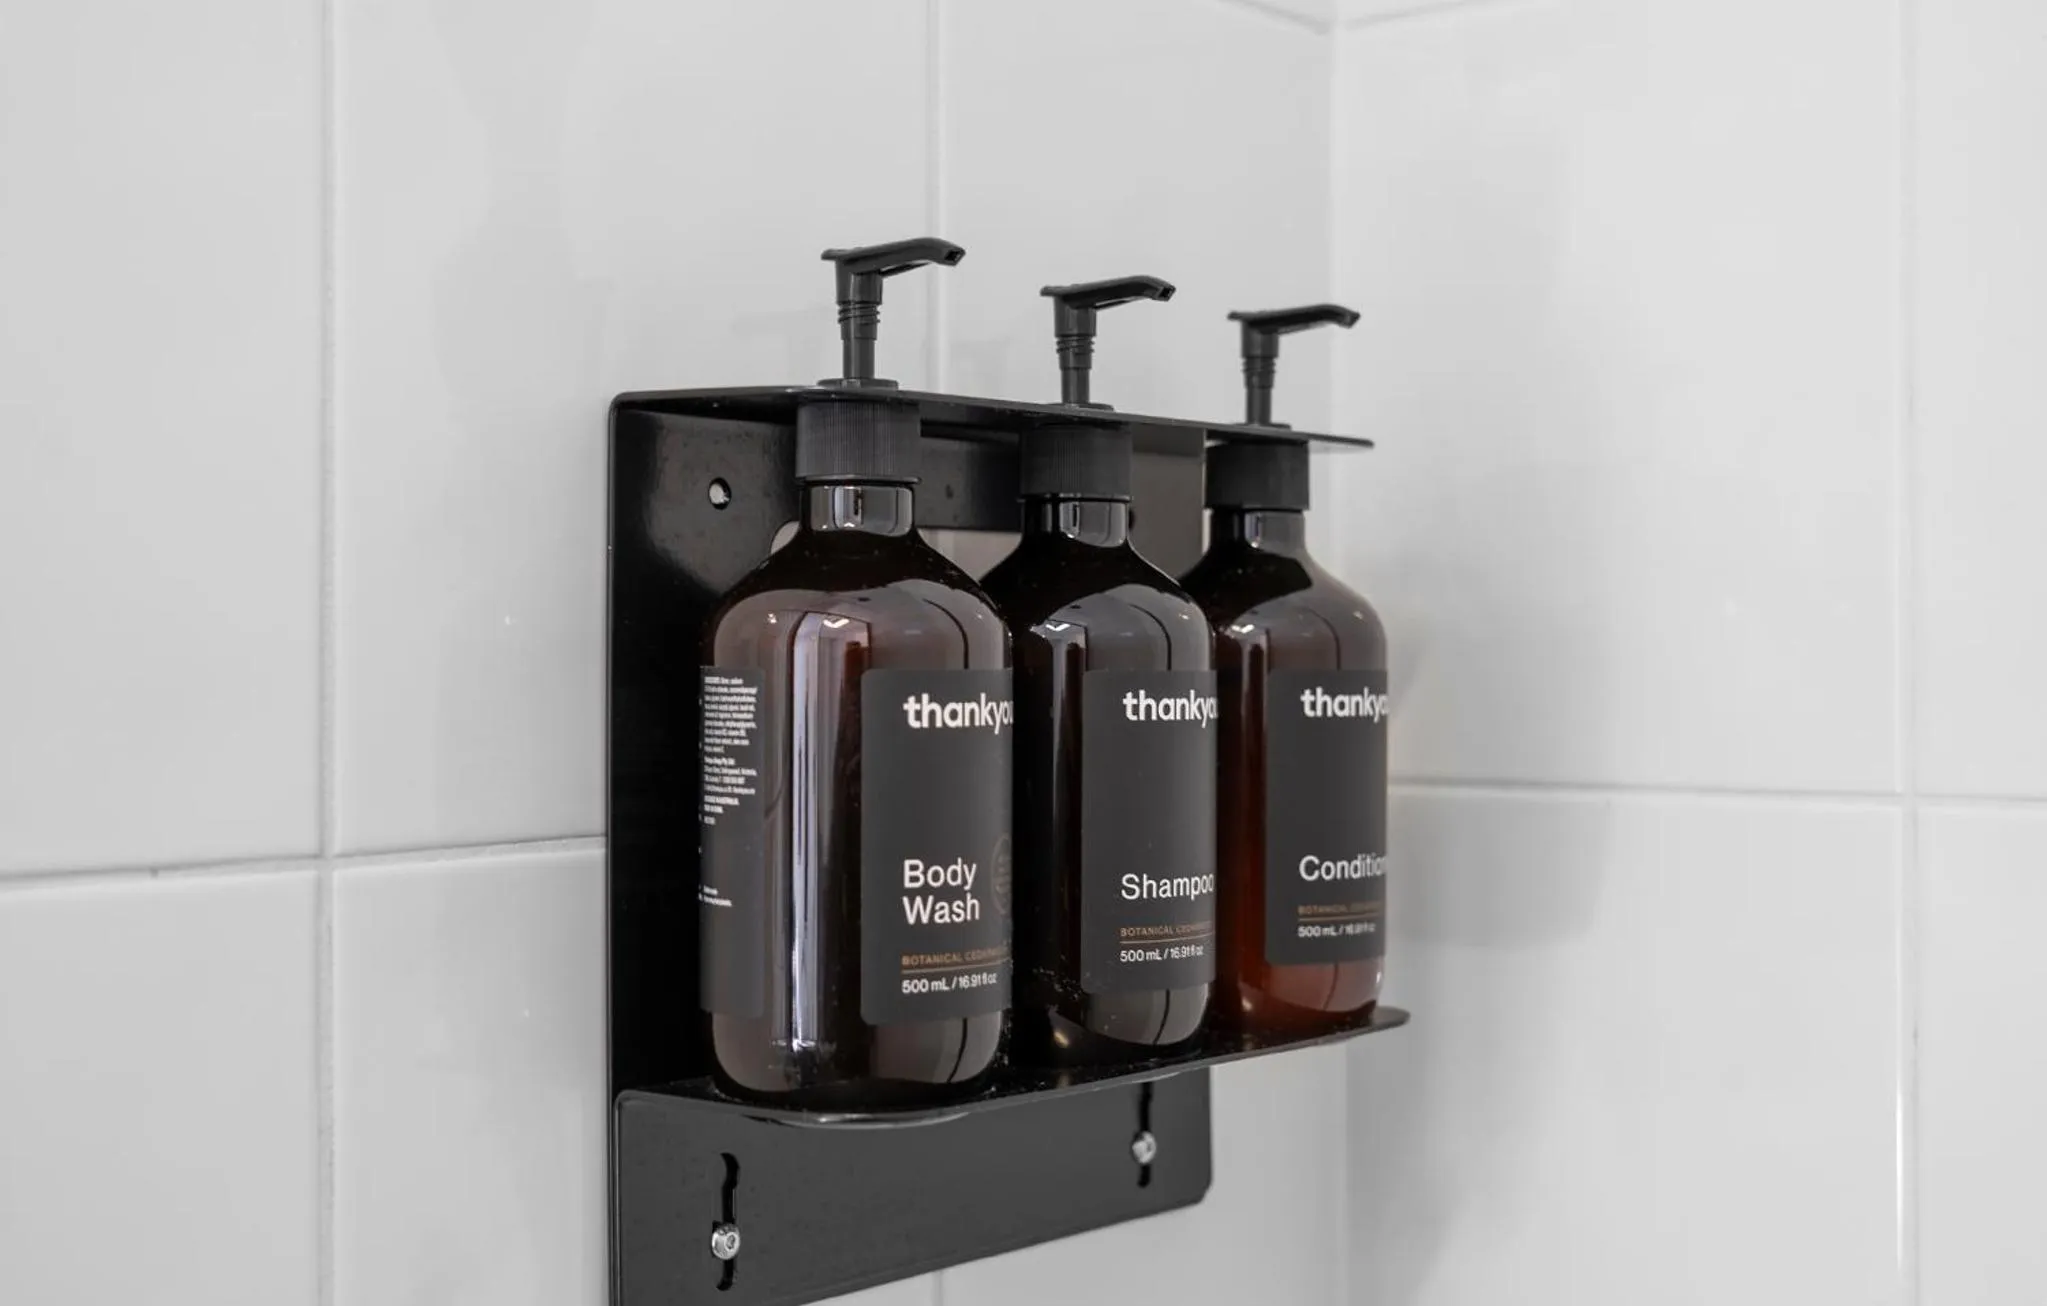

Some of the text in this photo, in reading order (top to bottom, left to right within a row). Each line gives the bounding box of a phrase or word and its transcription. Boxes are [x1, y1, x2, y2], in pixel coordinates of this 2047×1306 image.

[903, 857, 977, 890] Body
[1121, 873, 1214, 901] Shampoo
[902, 892, 980, 925] Wash
[1120, 925, 1173, 937] BOTANICAL
[1298, 925, 1320, 938] 500
[901, 952, 962, 966] BOTANICAL
[1120, 949, 1145, 962] 500
[1146, 948, 1162, 961] mL
[902, 978, 929, 994] 500
[930, 977, 950, 991] mL
